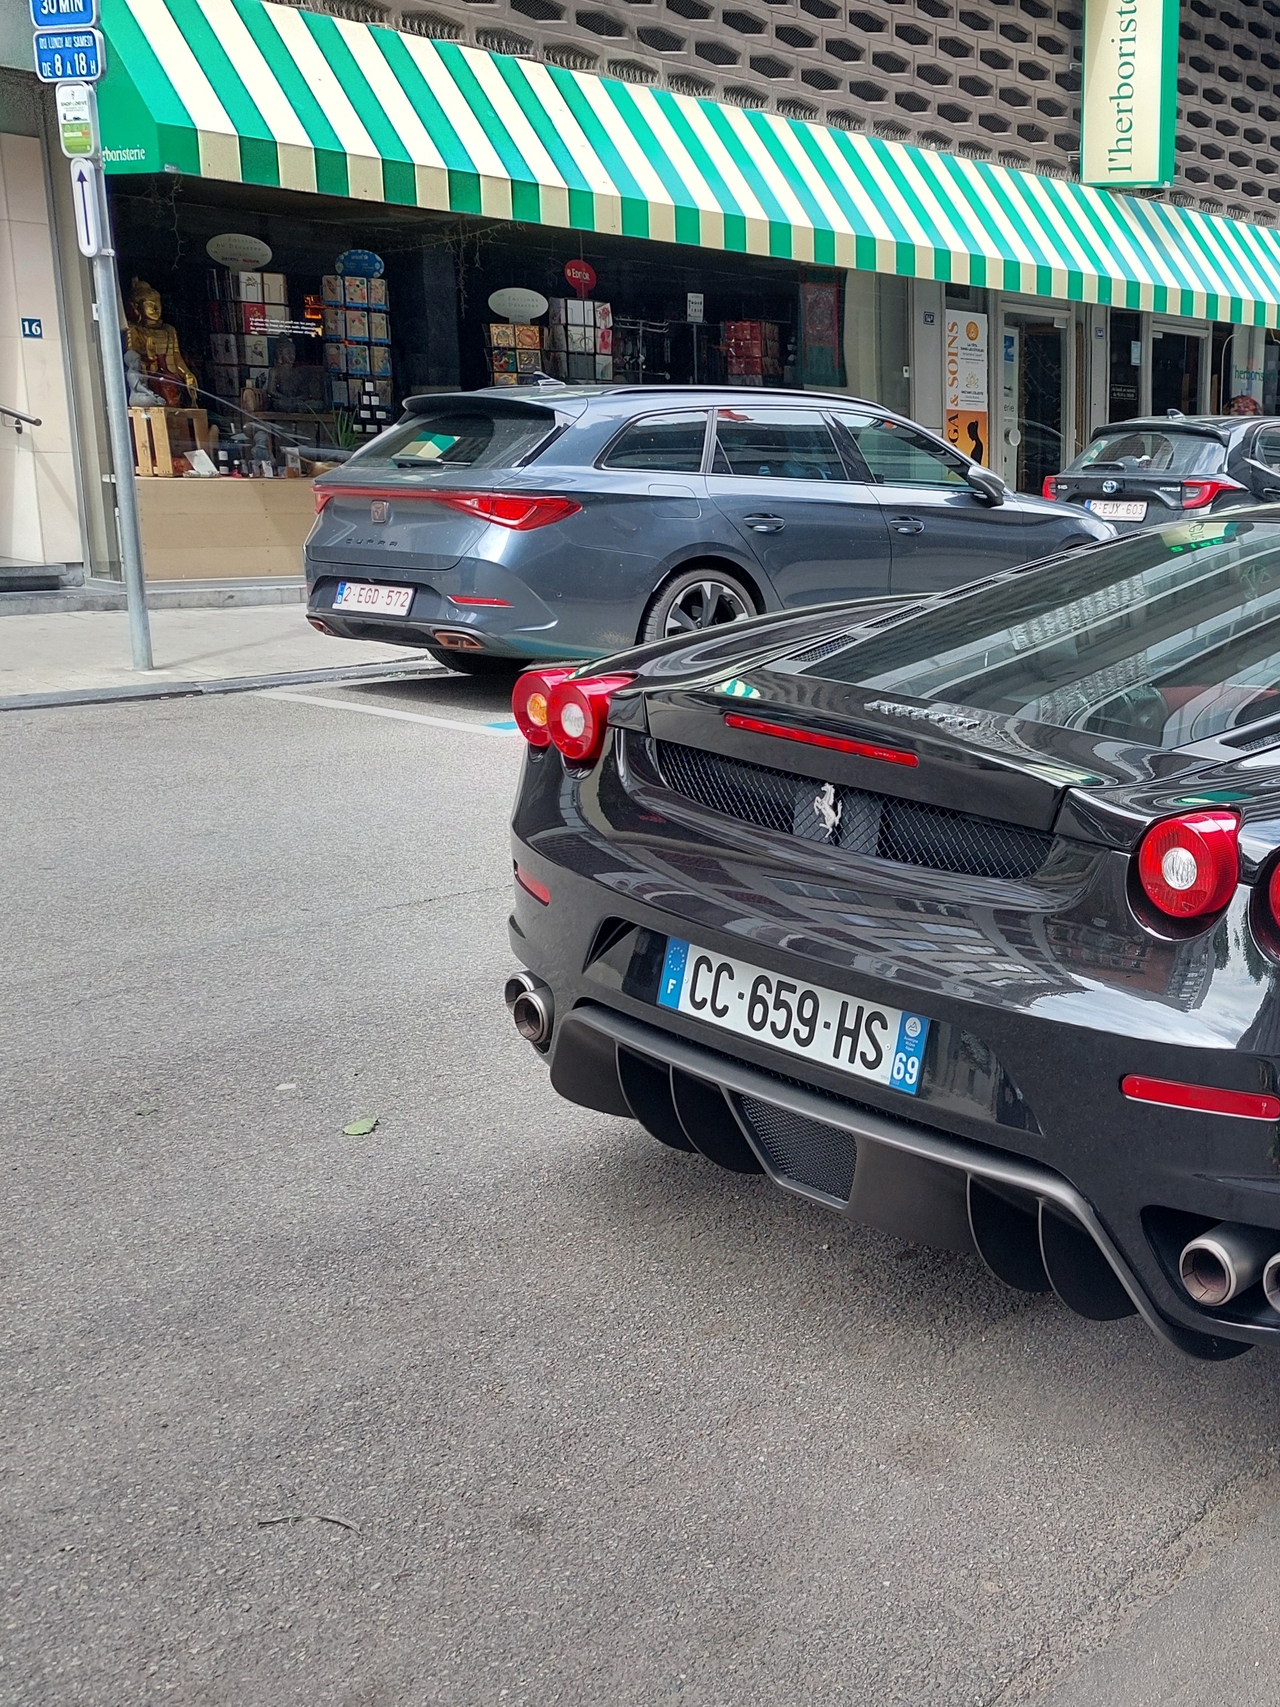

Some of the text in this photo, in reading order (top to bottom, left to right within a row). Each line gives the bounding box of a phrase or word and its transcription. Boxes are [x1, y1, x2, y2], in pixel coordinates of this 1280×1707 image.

[59, 0, 83, 13] MIN
[41, 52, 97, 77] DE 8 A 18 H
[1108, 0, 1138, 174] l'herborist
[23, 321, 41, 335] 16
[948, 321, 959, 389] SOINS
[948, 413, 959, 445] GA
[346, 538, 398, 547] CUPRA
[343, 586, 410, 608] 2-EGD-572
[666, 979, 677, 994] F
[689, 955, 889, 1070] CC-659-HS
[893, 1052, 920, 1085] 69
